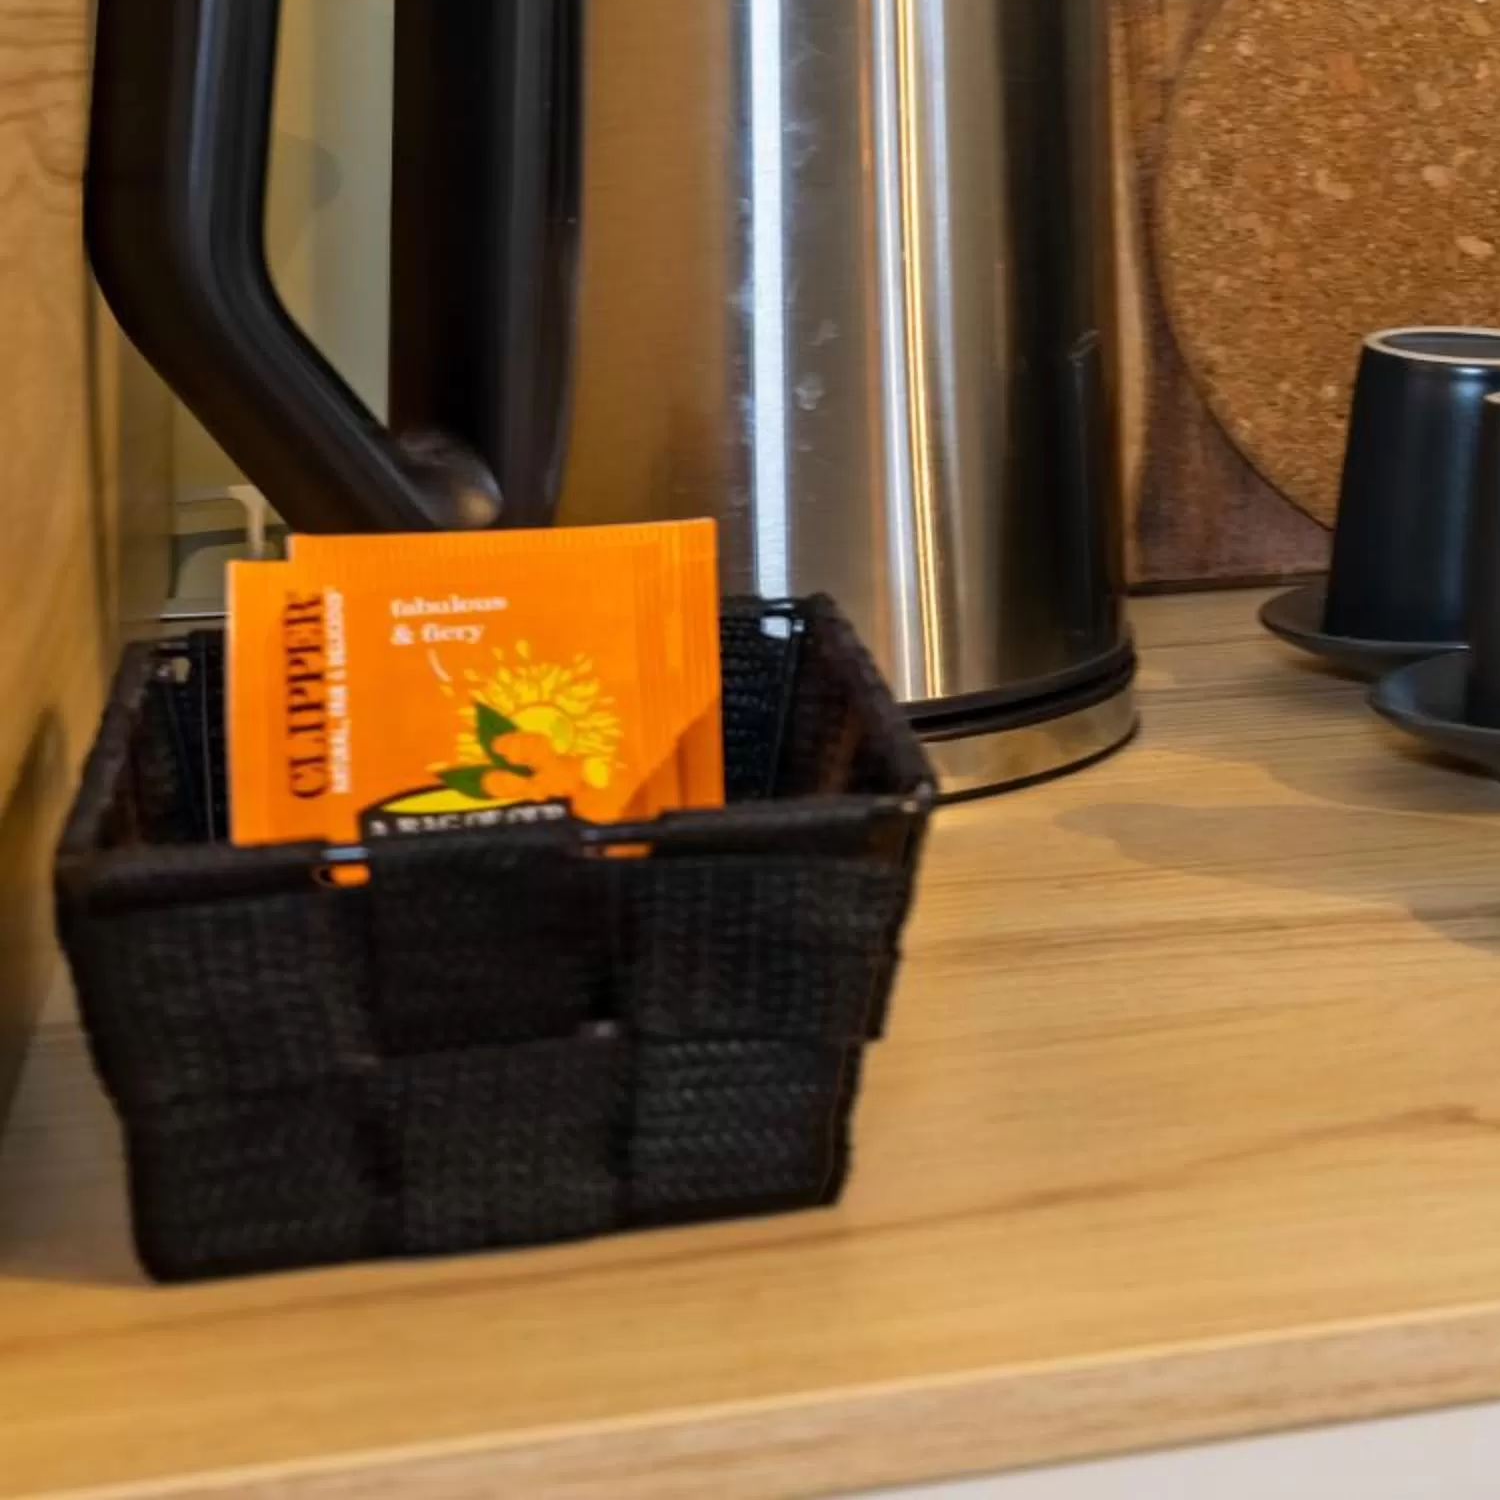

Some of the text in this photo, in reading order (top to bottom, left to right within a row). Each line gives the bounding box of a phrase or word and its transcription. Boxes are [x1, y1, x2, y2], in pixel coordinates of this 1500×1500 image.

[390, 593, 508, 619] fabulous
[390, 623, 415, 645] &
[285, 591, 326, 800] CLIPPER
